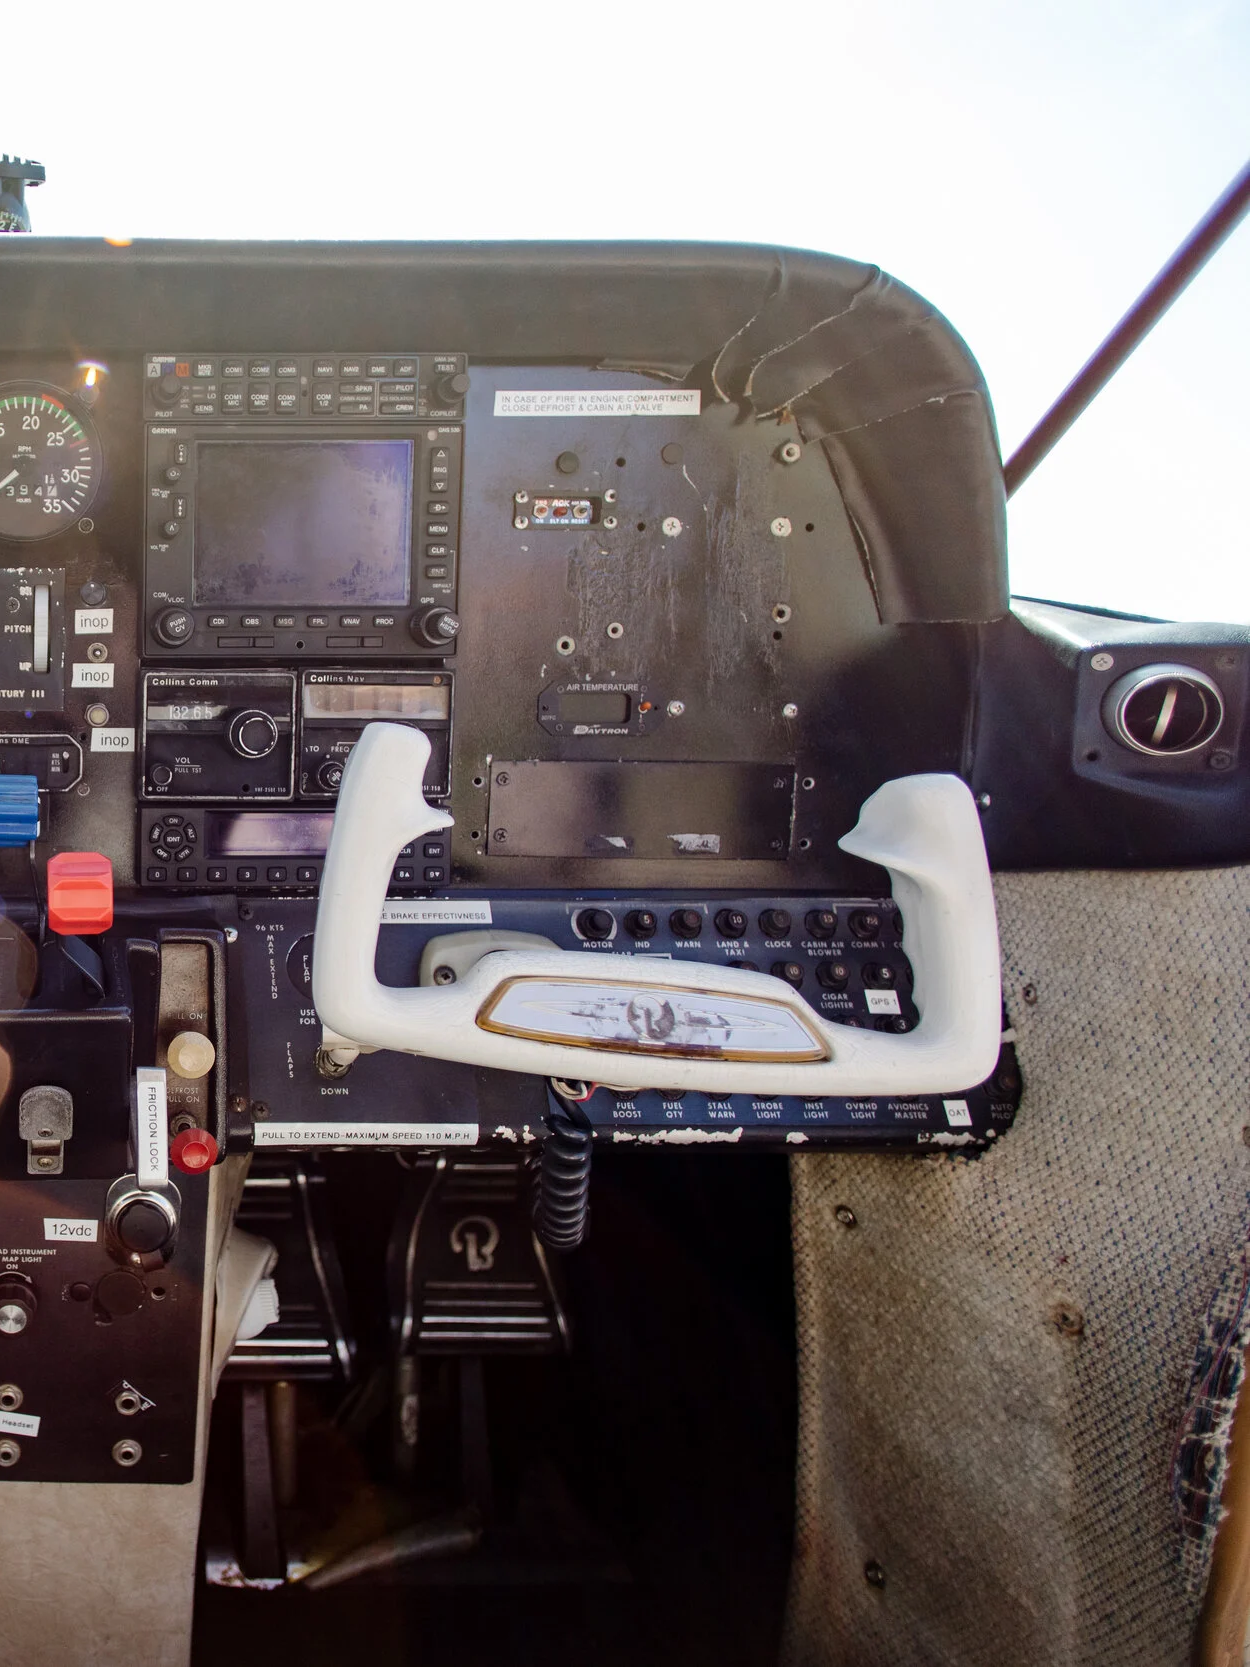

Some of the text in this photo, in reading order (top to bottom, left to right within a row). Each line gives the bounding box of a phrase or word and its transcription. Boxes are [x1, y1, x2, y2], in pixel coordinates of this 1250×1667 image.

[514, 395, 538, 403] CASE
[541, 395, 552, 403] OF
[556, 395, 575, 403] FIRE
[578, 395, 587, 403] IN
[590, 395, 624, 403] ENGINE
[627, 394, 695, 403] COMPARTMENT
[502, 404, 531, 412] CLOSE
[534, 404, 575, 412] DEFROST
[578, 404, 584, 412] &
[587, 404, 614, 412] CABIN
[617, 404, 632, 412] AIR
[22, 416, 40, 430] 20
[47, 432, 65, 447] 25
[17, 445, 32, 453] RPM
[61, 469, 80, 484] 30
[43, 498, 62, 513] 35
[429, 526, 448, 534] MENU
[80, 615, 109, 629] inop
[4, 625, 32, 634] PITCH
[81, 670, 110, 683] inop
[310, 674, 365, 683] Collins Nav
[152, 678, 219, 686] Collins Comm
[566, 683, 639, 692] AIR TEMPERATURE
[573, 725, 628, 735] DAVTRON
[12, 736, 30, 745] DME
[100, 734, 129, 748] inop
[428, 847, 441, 855] ENT
[390, 912, 487, 921] BRAKE EFFECTIVNESS
[583, 941, 614, 949] MOTOR
[634, 941, 650, 949] IND
[675, 941, 701, 949] WARN
[302, 955, 311, 984] FLAP
[821, 993, 848, 1001] CIGAR
[820, 1001, 854, 1009] LIGHTER
[300, 1008, 316, 1017] USE
[299, 1017, 317, 1025] FOR
[321, 1087, 349, 1095] DOWN
[616, 1102, 636, 1110] FUEL
[662, 1102, 684, 1110] FUEL
[707, 1102, 733, 1110] STALL
[751, 1102, 784, 1110] STROBE
[887, 1103, 930, 1111] AVIONICS
[612, 1110, 642, 1118] BOOST
[708, 1111, 736, 1119] WARN
[756, 1111, 782, 1119] LIGHT
[803, 1111, 829, 1119] LIGHT
[850, 1111, 877, 1119] LIGHT
[894, 1112, 928, 1120] MASTER
[948, 1108, 967, 1117] OAT
[147, 1086, 159, 1172] FRICTION LOCK
[262, 1132, 473, 1140] PULL TO EXTEND-MAXIMUM SPEED 110 M.P.H.
[51, 1222, 93, 1238] 12vdc
[10, 1248, 57, 1256] INSTRUMENT
[21, 1256, 43, 1264] LIGHT
[1, 1418, 35, 1431] Headset
